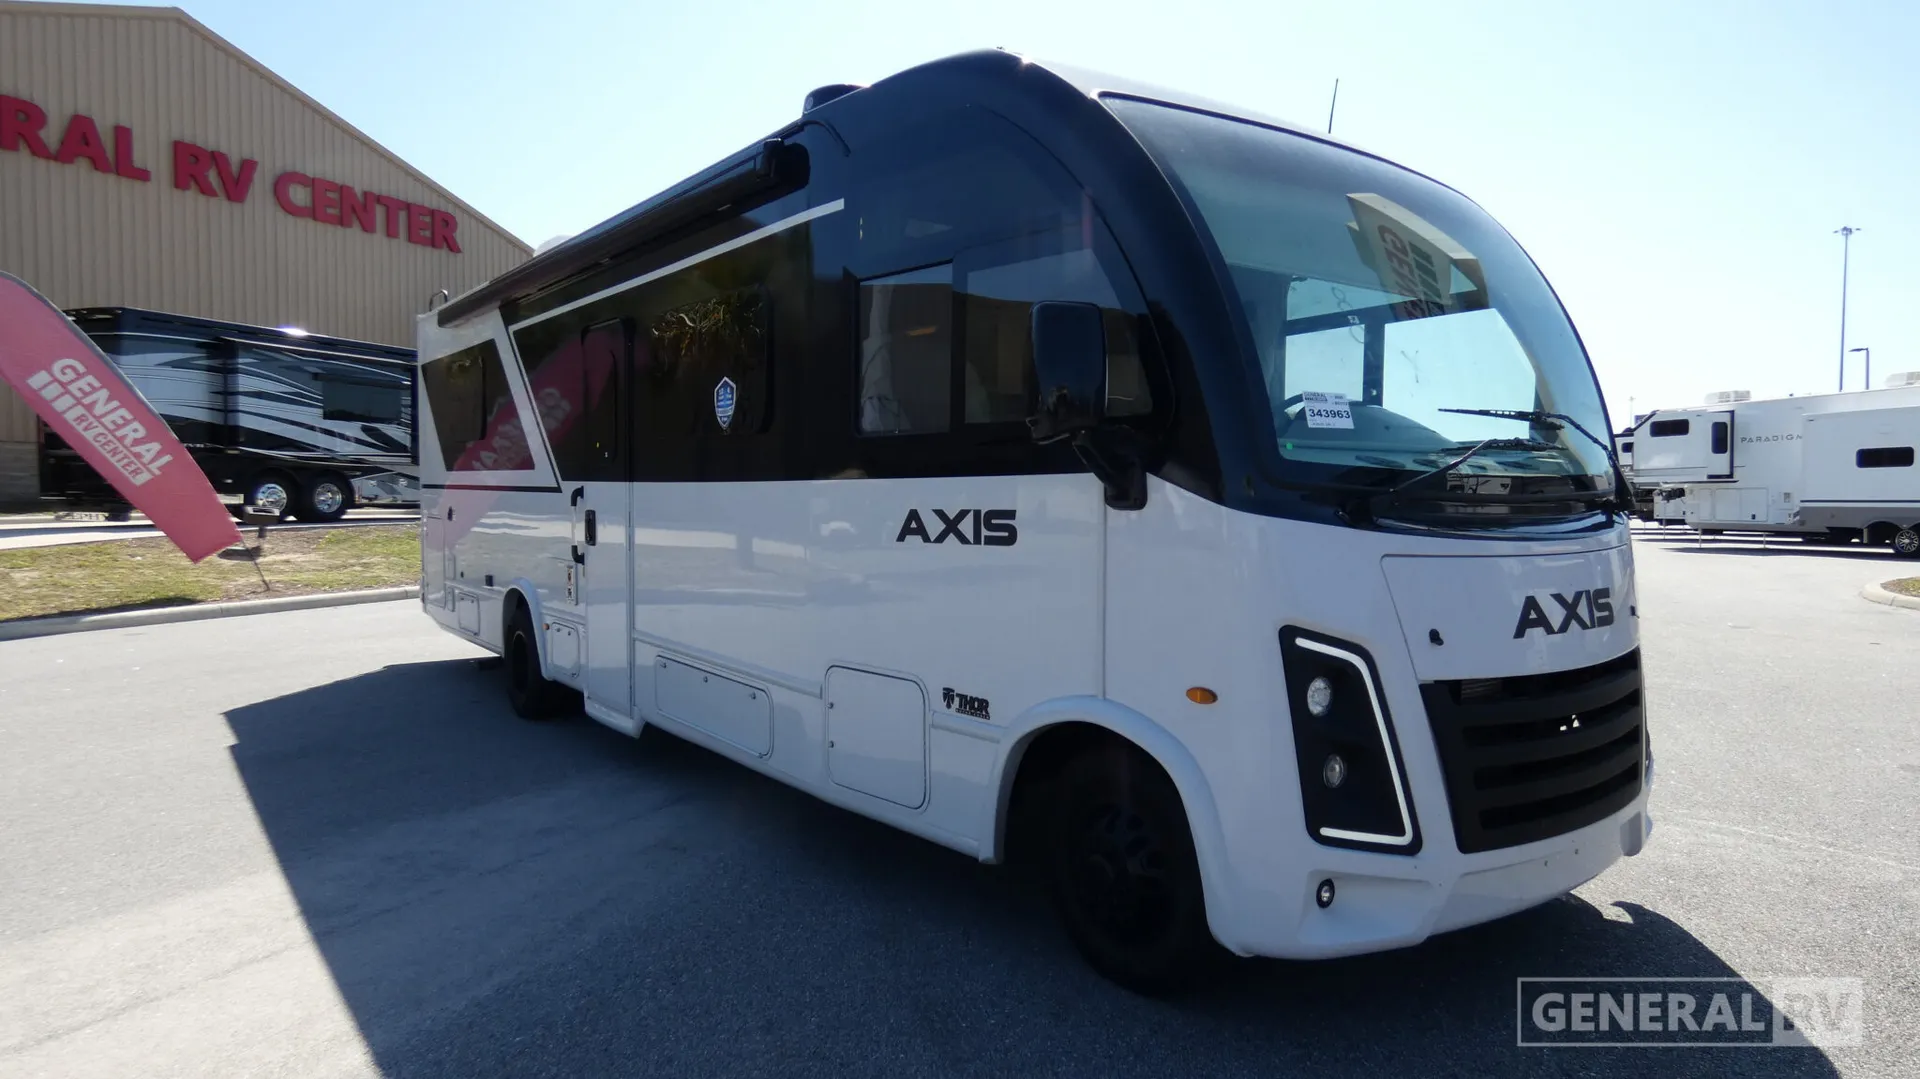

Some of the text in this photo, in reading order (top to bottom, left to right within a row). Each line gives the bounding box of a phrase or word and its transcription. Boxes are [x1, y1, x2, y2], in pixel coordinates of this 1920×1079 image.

[0, 94, 463, 254] RAL RV CENTER
[52, 358, 173, 476] GENERAL
[1308, 408, 1351, 419] 343963
[73, 413, 144, 480] RV CENTER
[896, 509, 1017, 546] AXIS
[1513, 587, 1614, 639] AXIS
[956, 693, 989, 715] THOR
